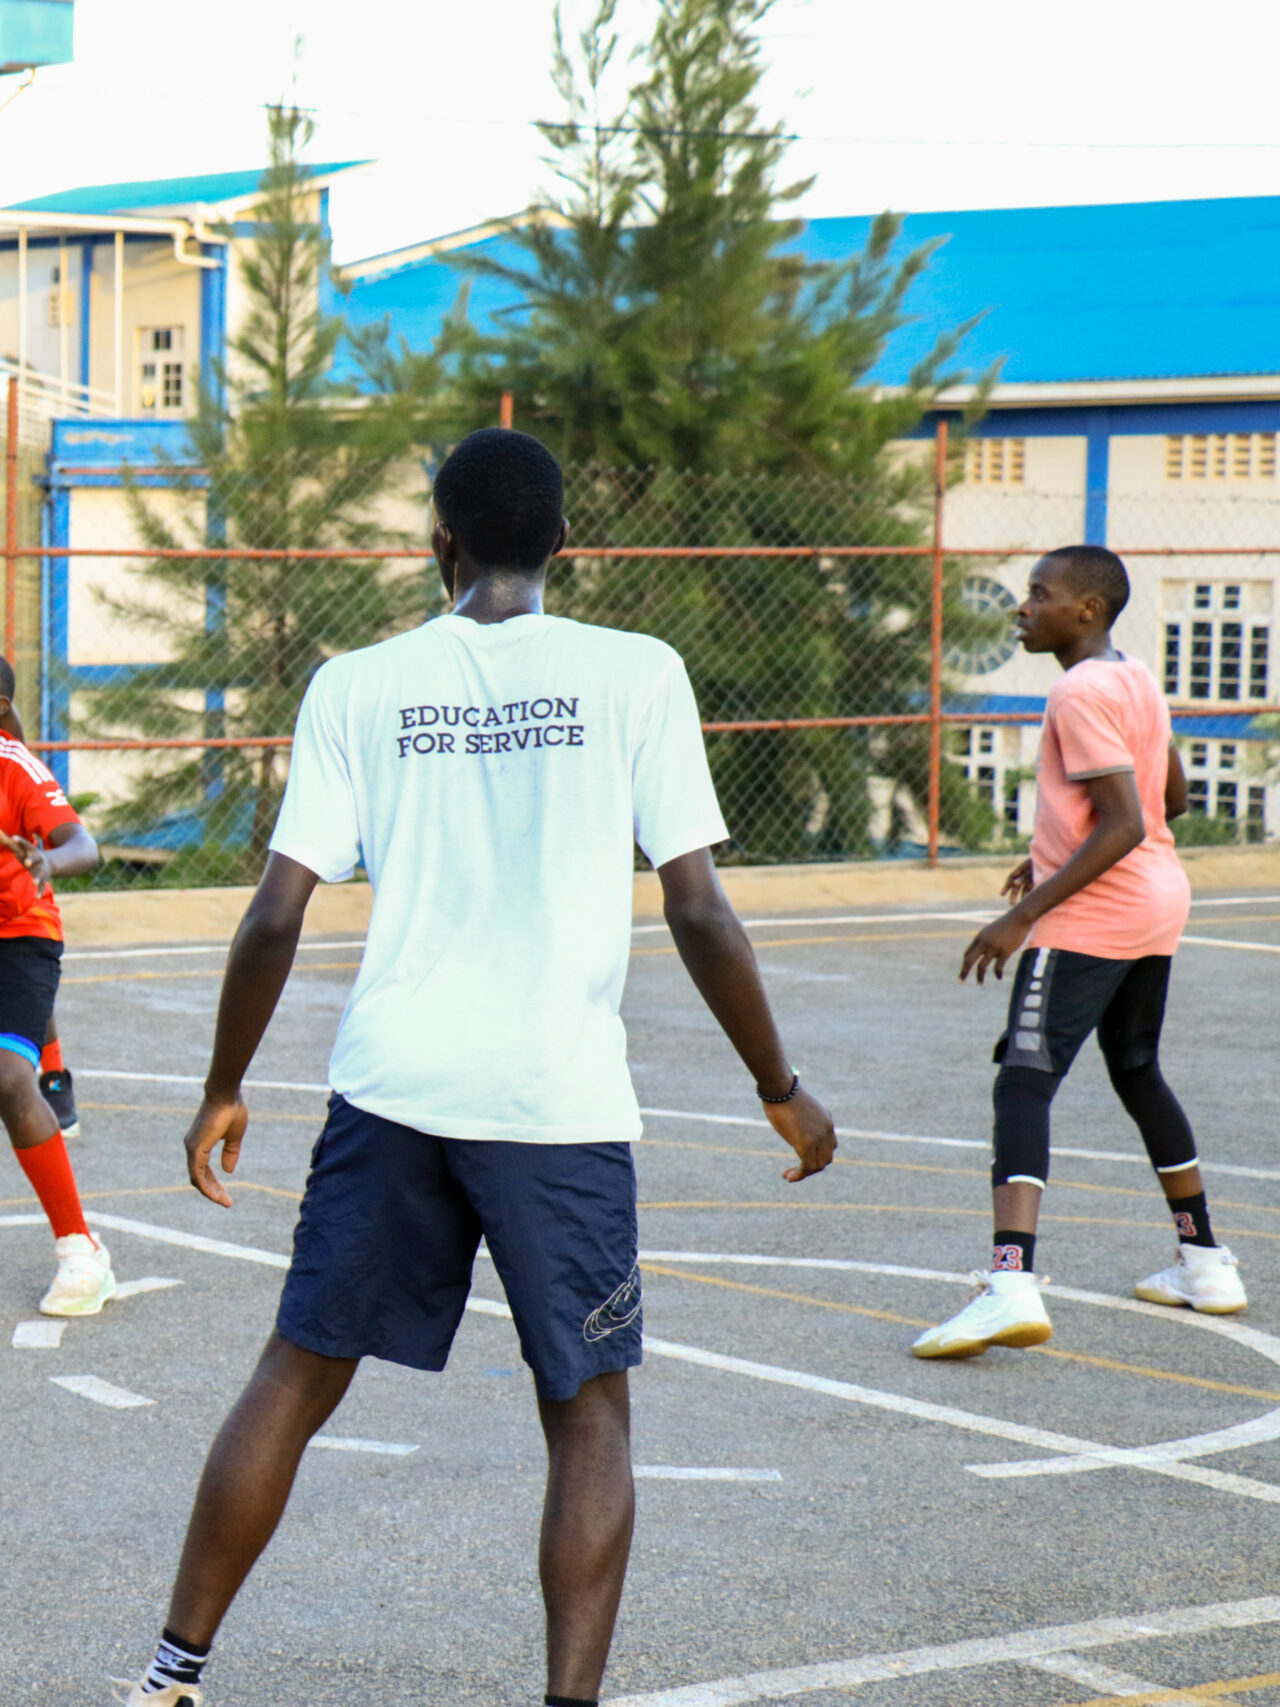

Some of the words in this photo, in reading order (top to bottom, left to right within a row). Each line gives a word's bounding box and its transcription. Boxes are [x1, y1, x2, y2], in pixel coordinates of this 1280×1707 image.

[398, 696, 580, 730] EDUCATION
[396, 732, 455, 758] FOR
[464, 724, 584, 754] SERVICE
[1173, 1212, 1198, 1237] 3
[992, 1244, 1024, 1271] 23
